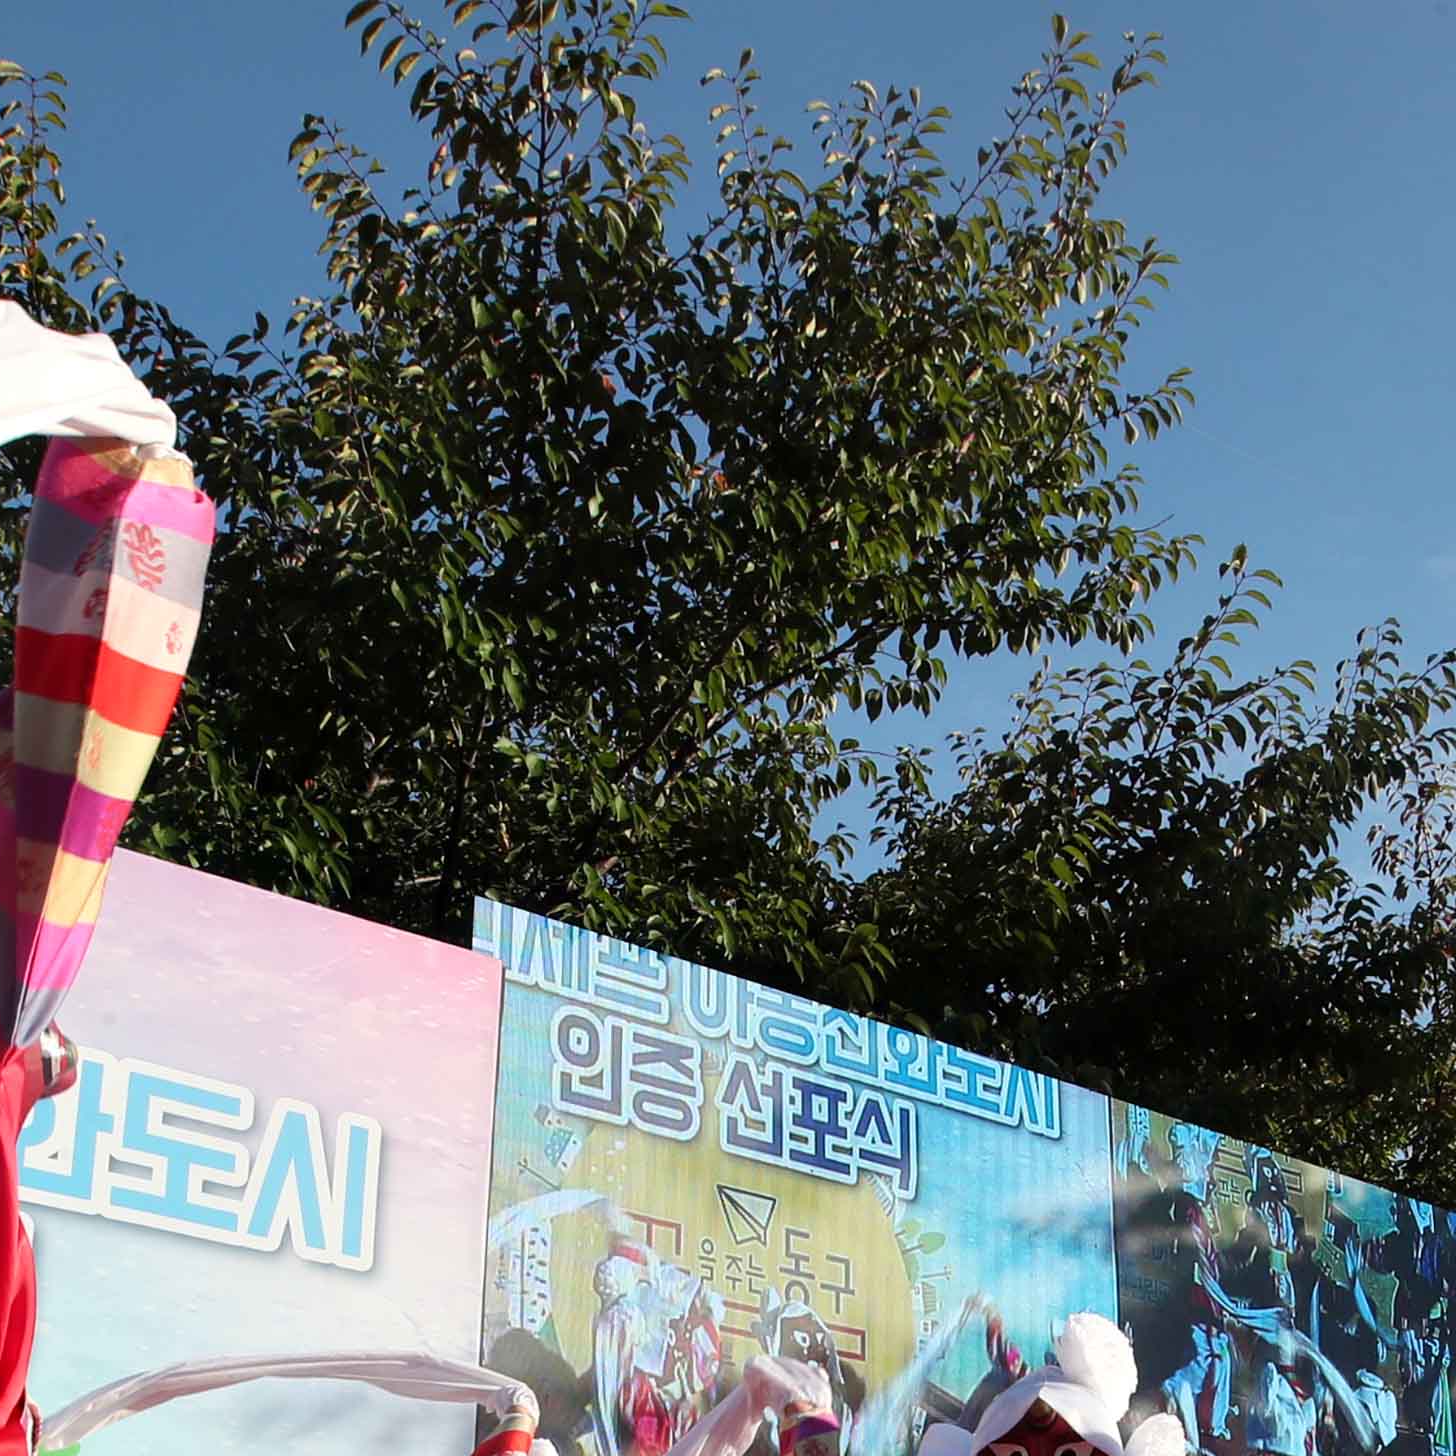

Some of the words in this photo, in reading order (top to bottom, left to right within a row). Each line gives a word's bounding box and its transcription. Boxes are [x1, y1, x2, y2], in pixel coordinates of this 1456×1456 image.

[557, 1013, 698, 1132] 인증
[720, 1059, 911, 1193] 선포식
[725, 1253, 766, 1295] 주는
[779, 1226, 856, 1315] 동구
